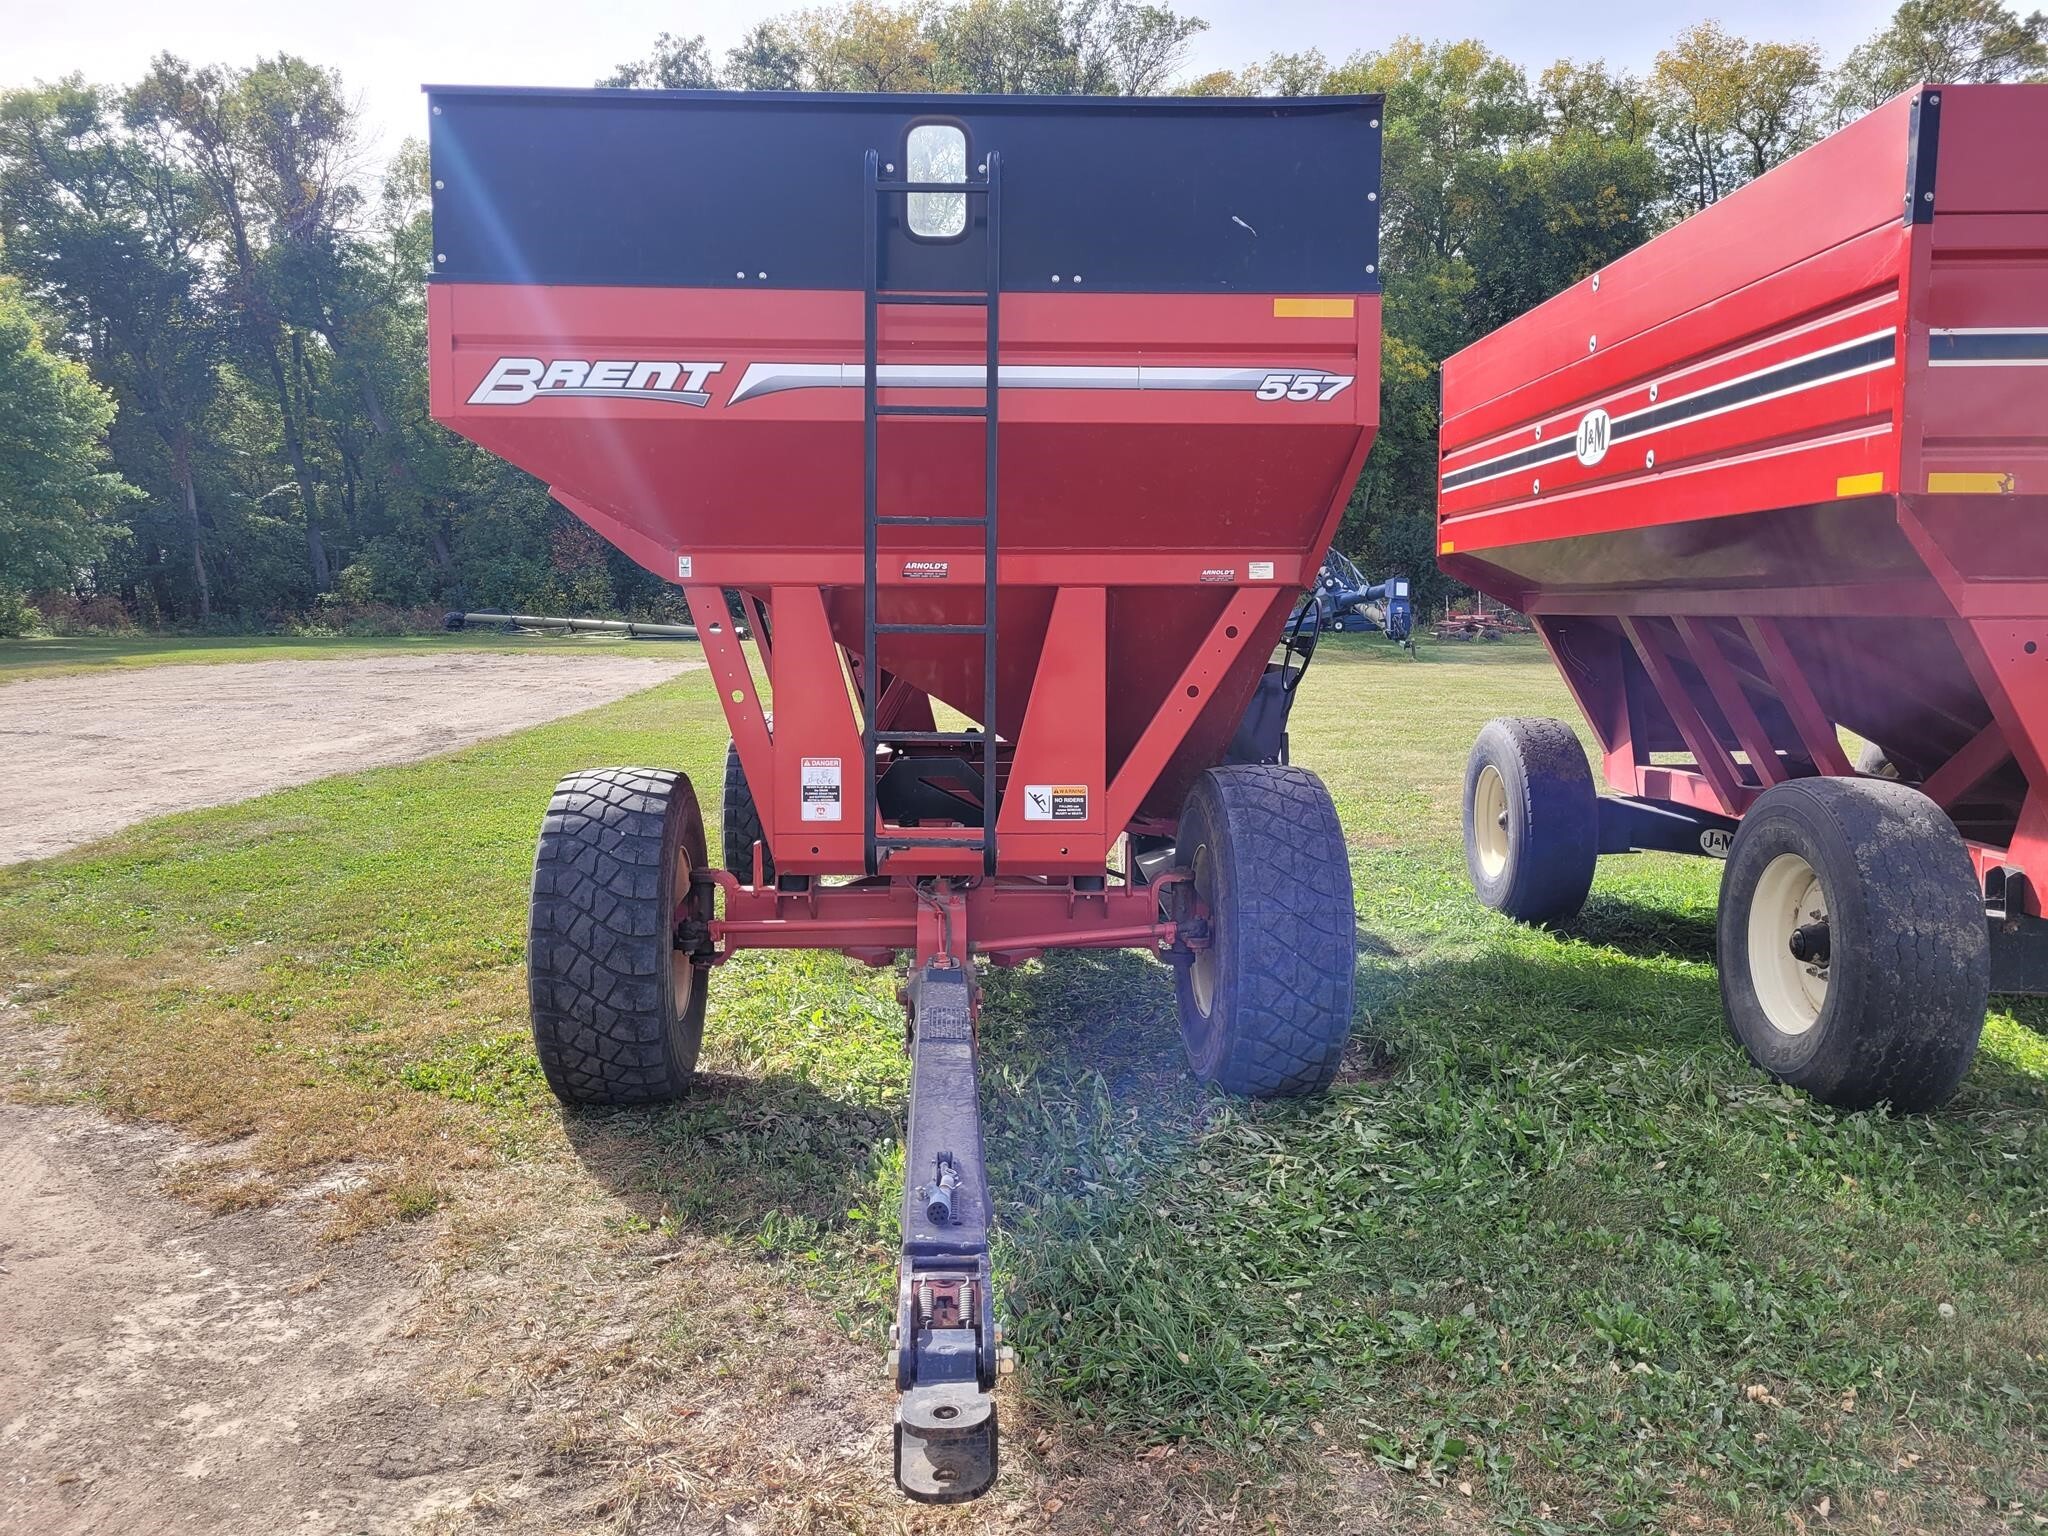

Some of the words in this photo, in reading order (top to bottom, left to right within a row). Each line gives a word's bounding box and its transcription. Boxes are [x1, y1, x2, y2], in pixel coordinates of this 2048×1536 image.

[465, 357, 727, 405] BRENT
[1255, 374, 1356, 402] 557
[1579, 414, 1607, 457] J&M
